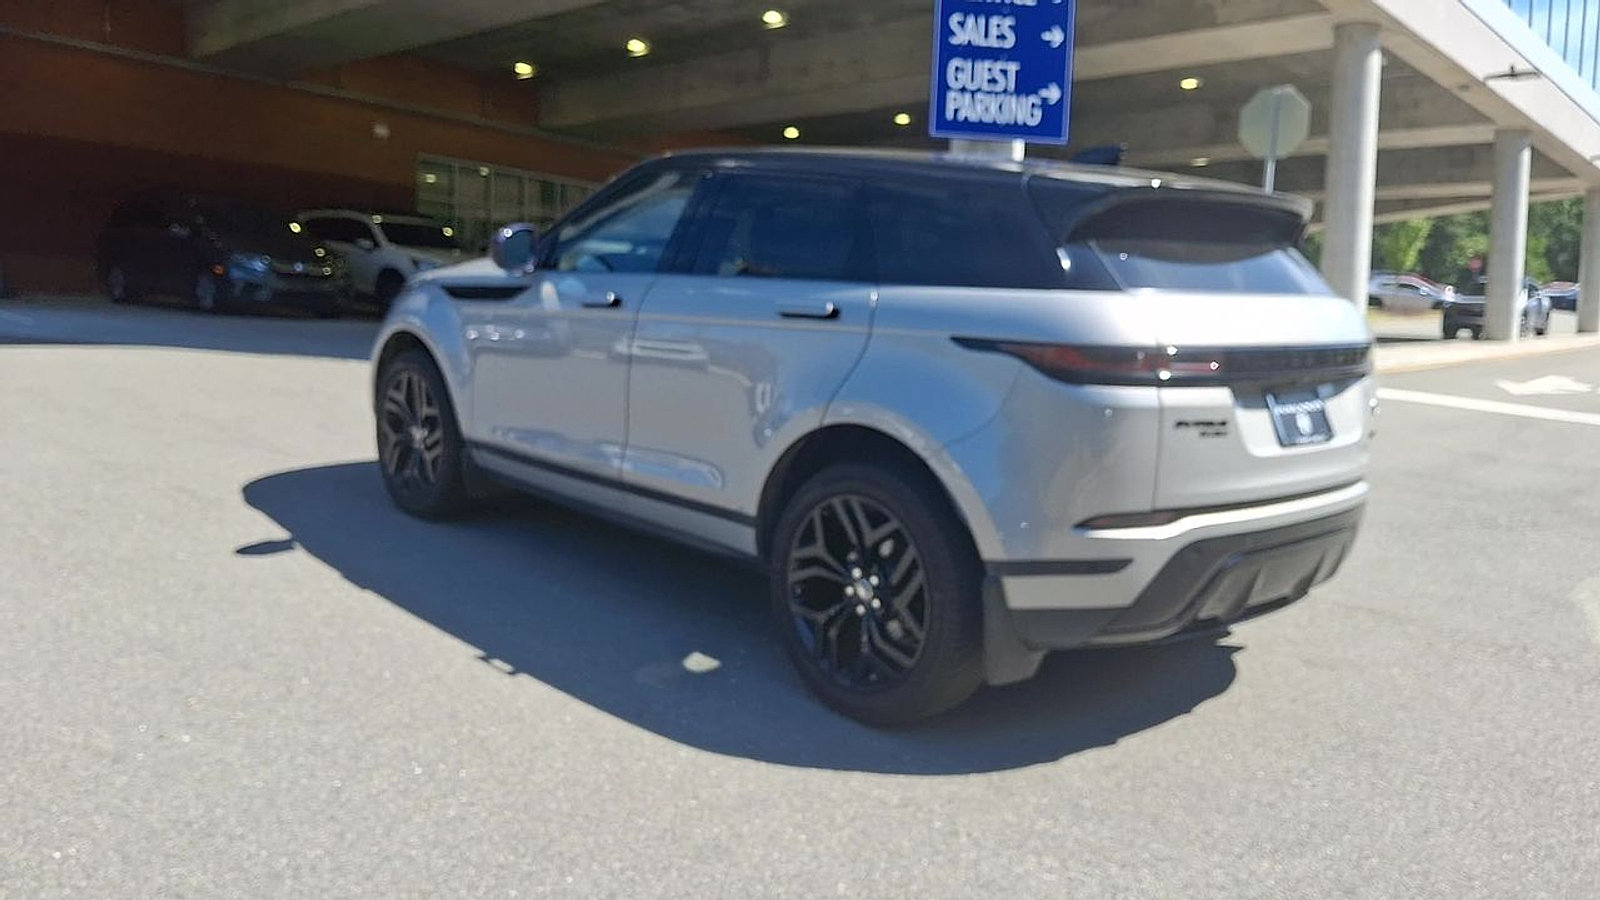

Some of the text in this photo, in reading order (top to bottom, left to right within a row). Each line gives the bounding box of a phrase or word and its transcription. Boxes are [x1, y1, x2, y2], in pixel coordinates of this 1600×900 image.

[948, 12, 1016, 49] SALES
[946, 57, 1020, 92] GUEST
[945, 91, 1042, 127] PARKING
